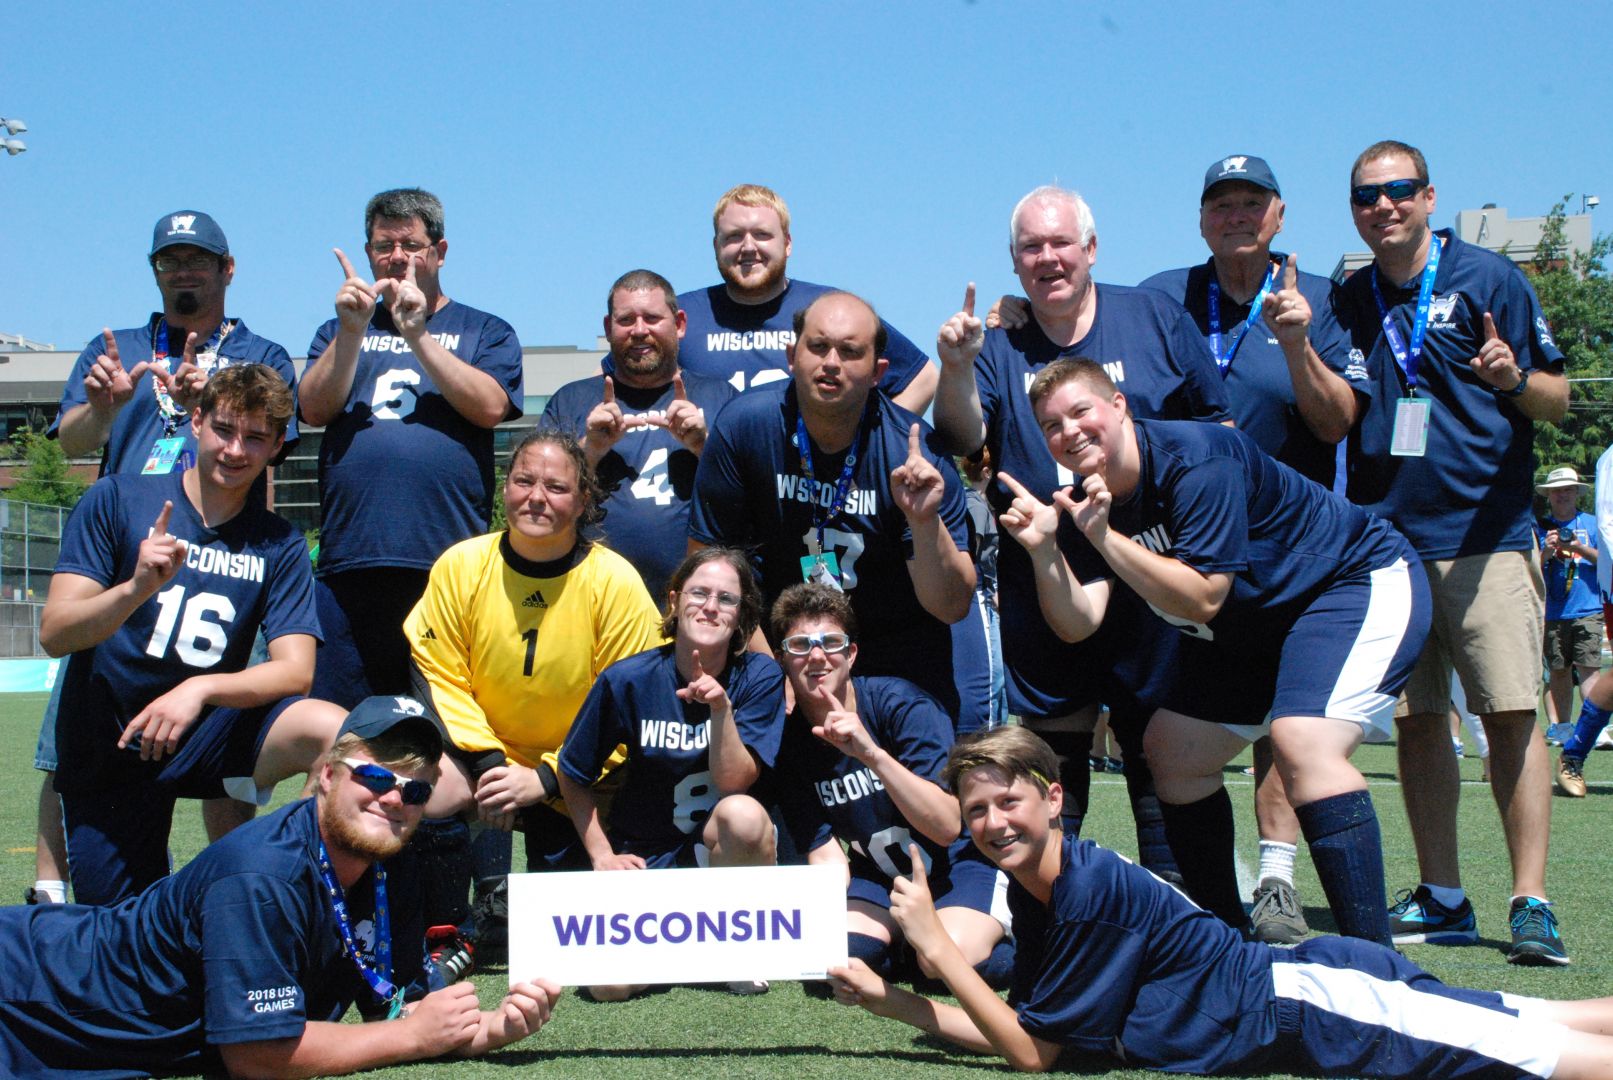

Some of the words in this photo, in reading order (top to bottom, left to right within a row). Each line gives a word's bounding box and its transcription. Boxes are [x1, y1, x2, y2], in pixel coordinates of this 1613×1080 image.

[371, 368, 421, 420] 6
[630, 448, 675, 506] 4
[145, 584, 237, 669] 16
[521, 628, 539, 677] 1
[552, 909, 802, 946] WISCONSIN
[247, 988, 276, 1001] 2018
[278, 986, 298, 998] USA
[254, 998, 295, 1013] GAMES
